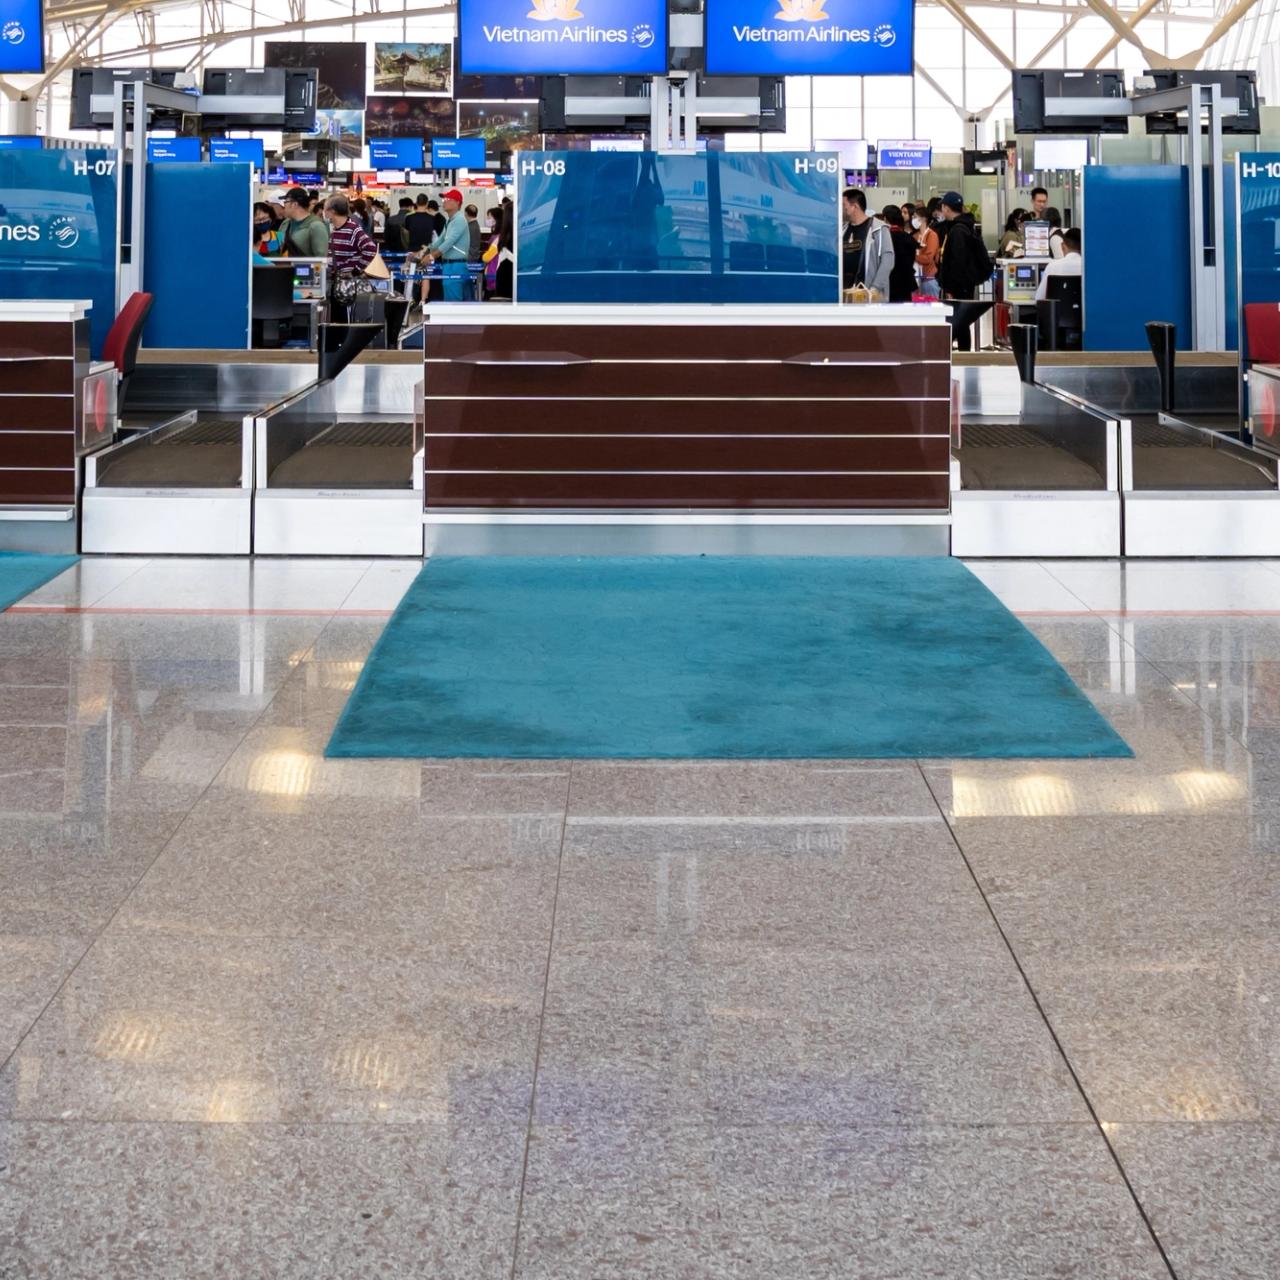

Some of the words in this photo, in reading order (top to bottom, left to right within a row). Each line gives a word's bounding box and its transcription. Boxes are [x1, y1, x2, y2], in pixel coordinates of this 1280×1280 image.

[483, 25, 559, 43] Vietnam
[560, 25, 628, 43] Airlines
[733, 25, 805, 42] Vietnam
[806, 25, 870, 42] Airlines
[73, 160, 116, 176] H-07
[521, 159, 566, 177] H-08
[794, 157, 838, 174] H-09
